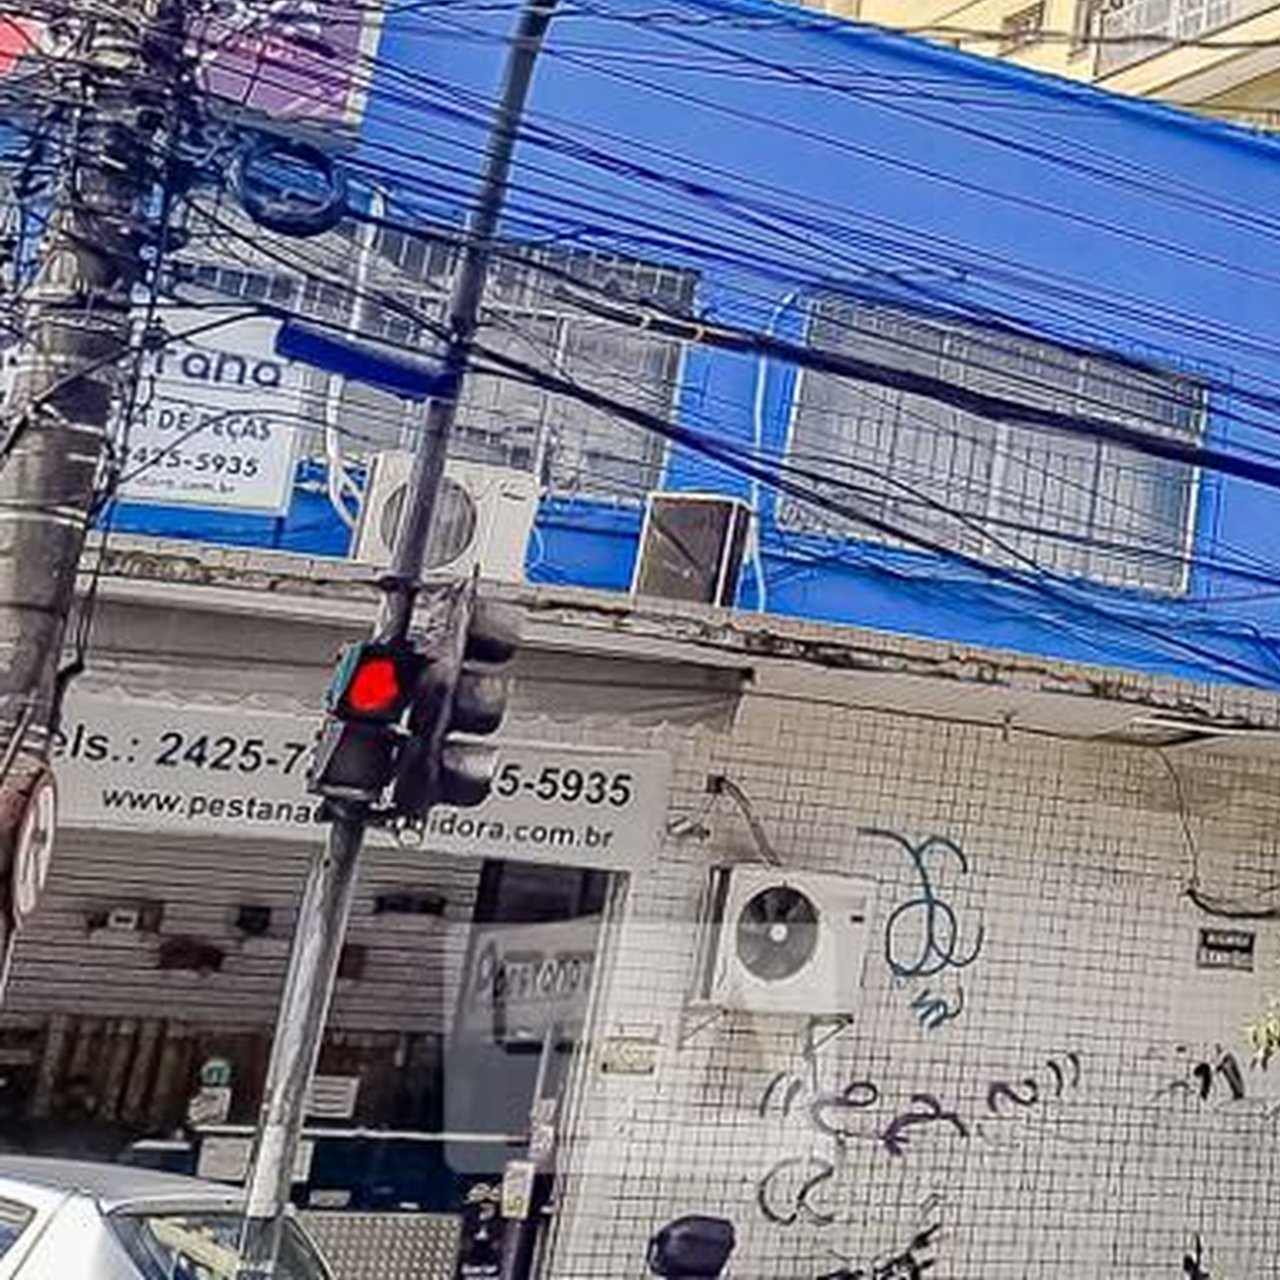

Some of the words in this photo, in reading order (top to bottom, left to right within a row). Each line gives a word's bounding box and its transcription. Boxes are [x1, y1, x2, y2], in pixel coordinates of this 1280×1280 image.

[131, 446, 260, 477] 425-5935
[52, 723, 139, 763] els.:
[496, 763, 634, 807] 5-5935
